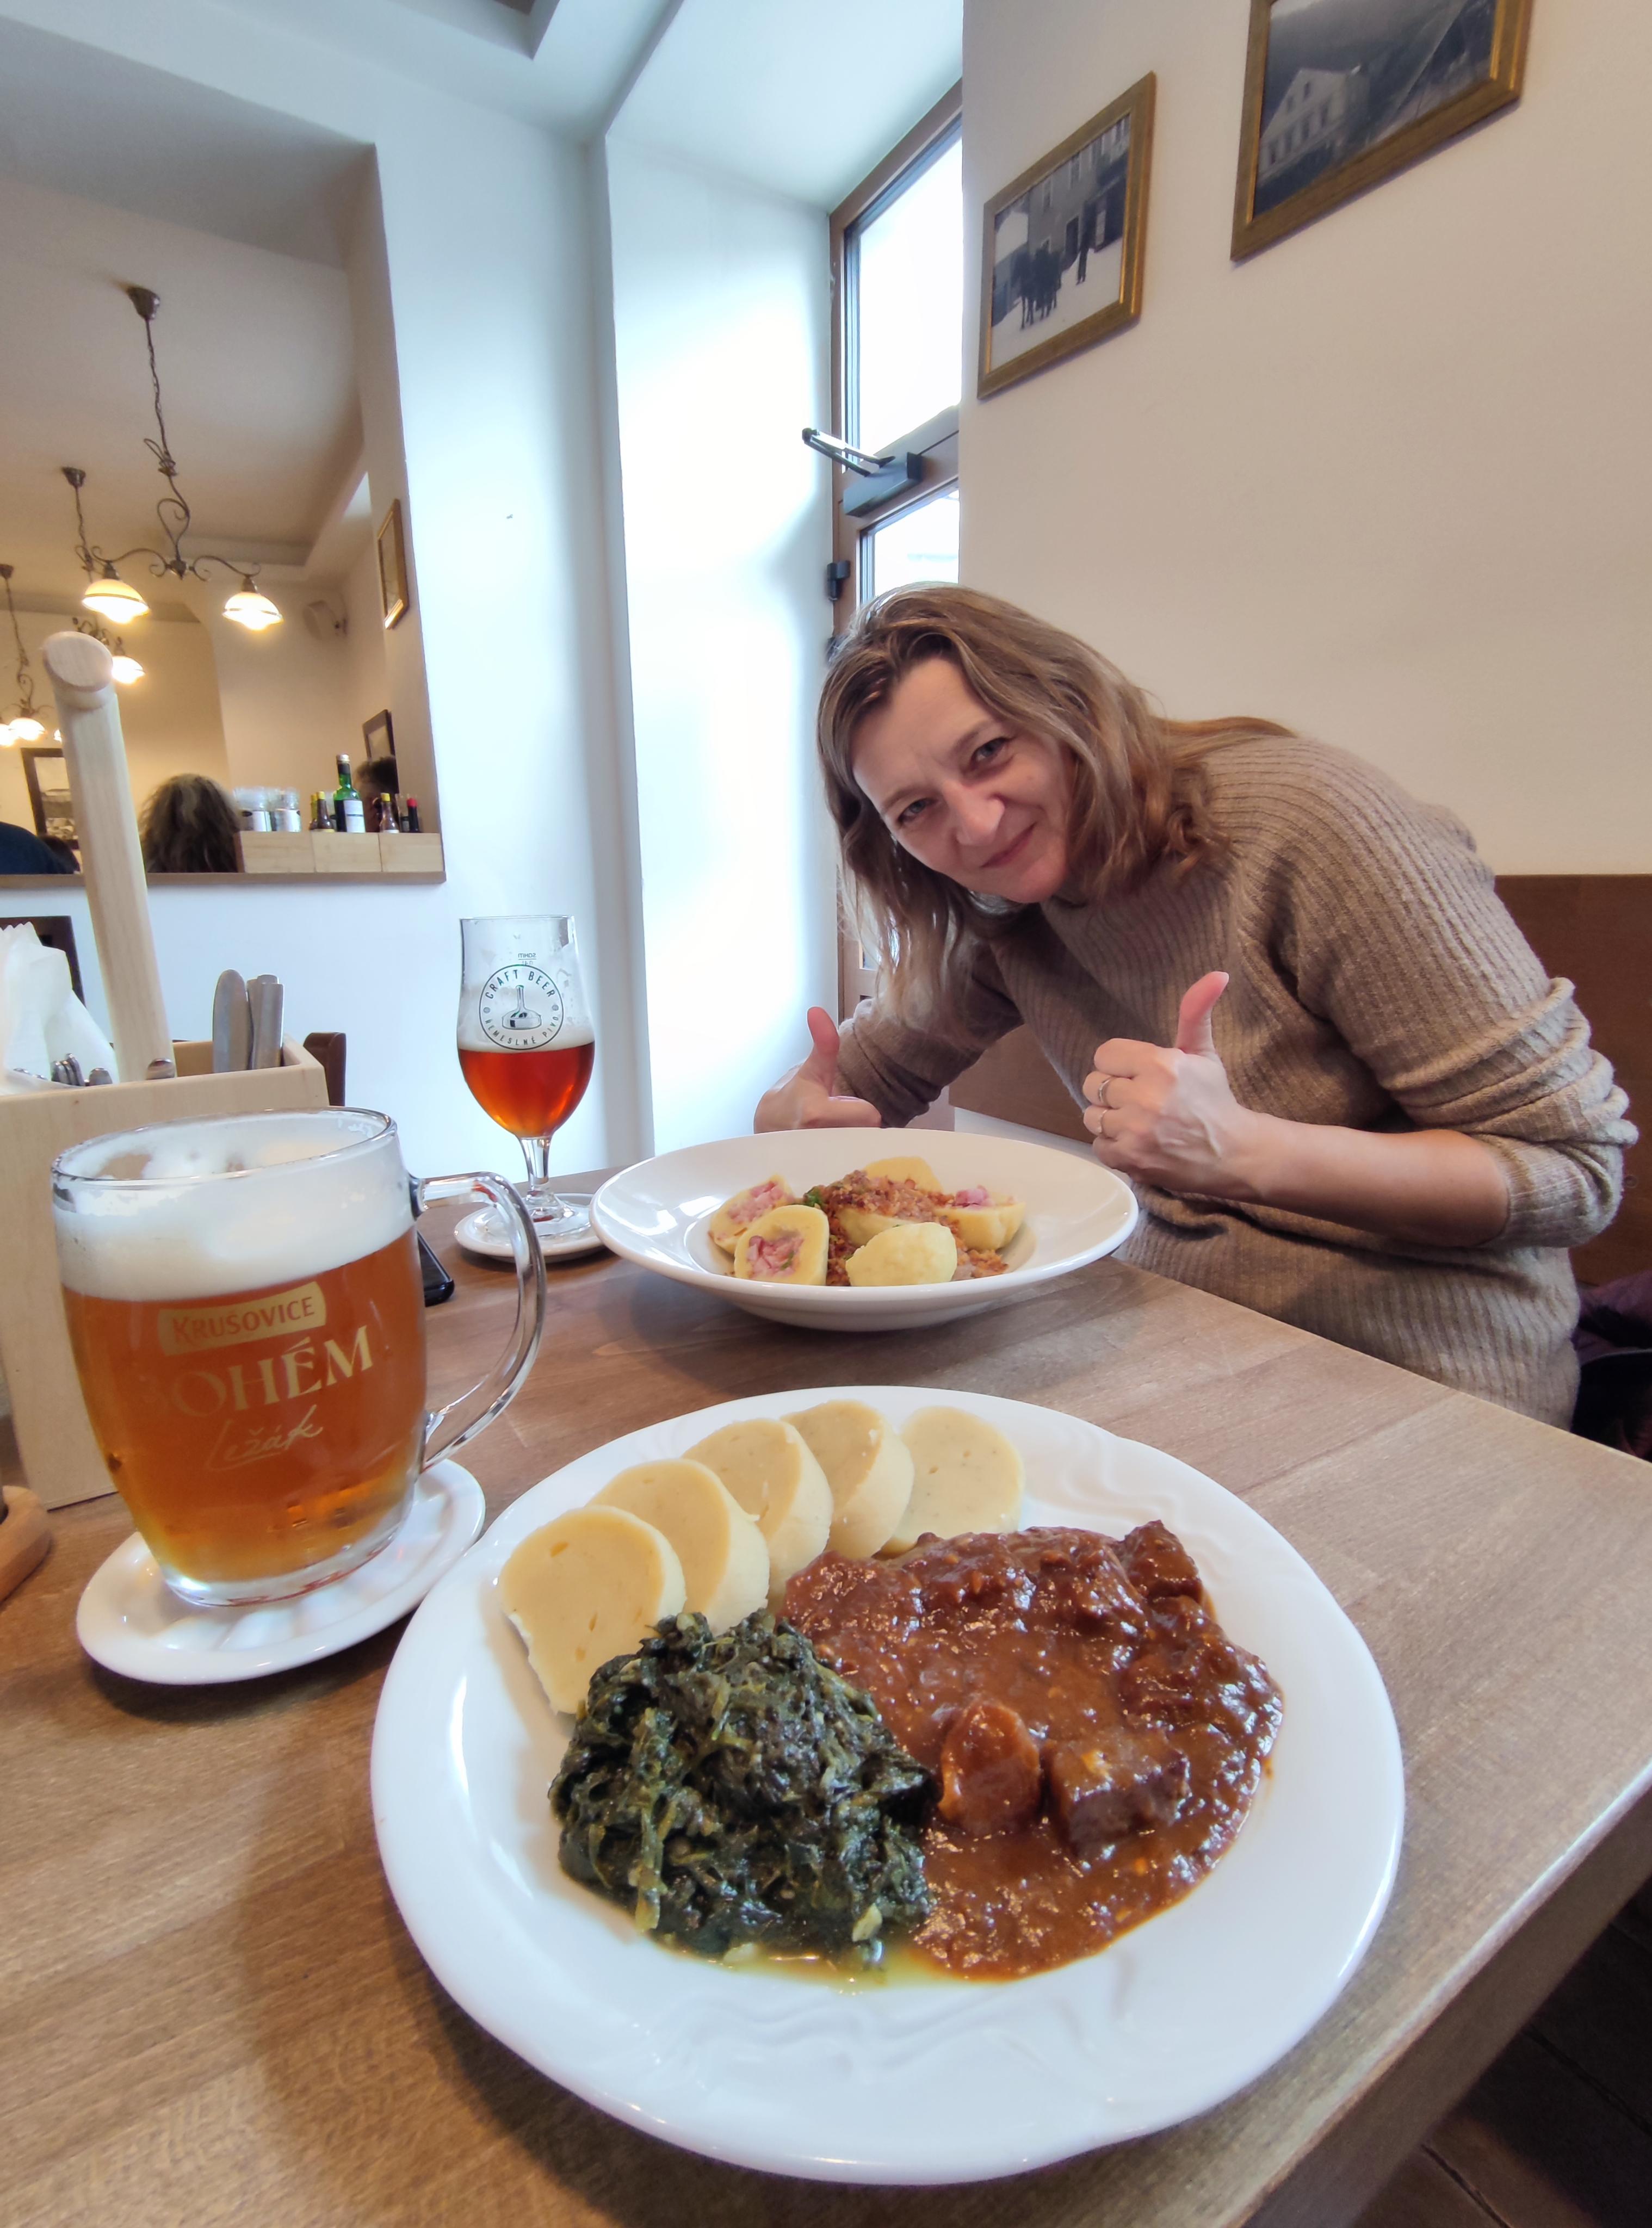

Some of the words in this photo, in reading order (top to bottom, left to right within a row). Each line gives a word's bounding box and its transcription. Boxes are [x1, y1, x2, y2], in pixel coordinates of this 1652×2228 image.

[485, 969, 518, 999] CRAFT
[528, 970, 555, 997] BEER
[541, 1016, 559, 1038] PIVO
[133, 1325, 373, 1418] OHÉM
